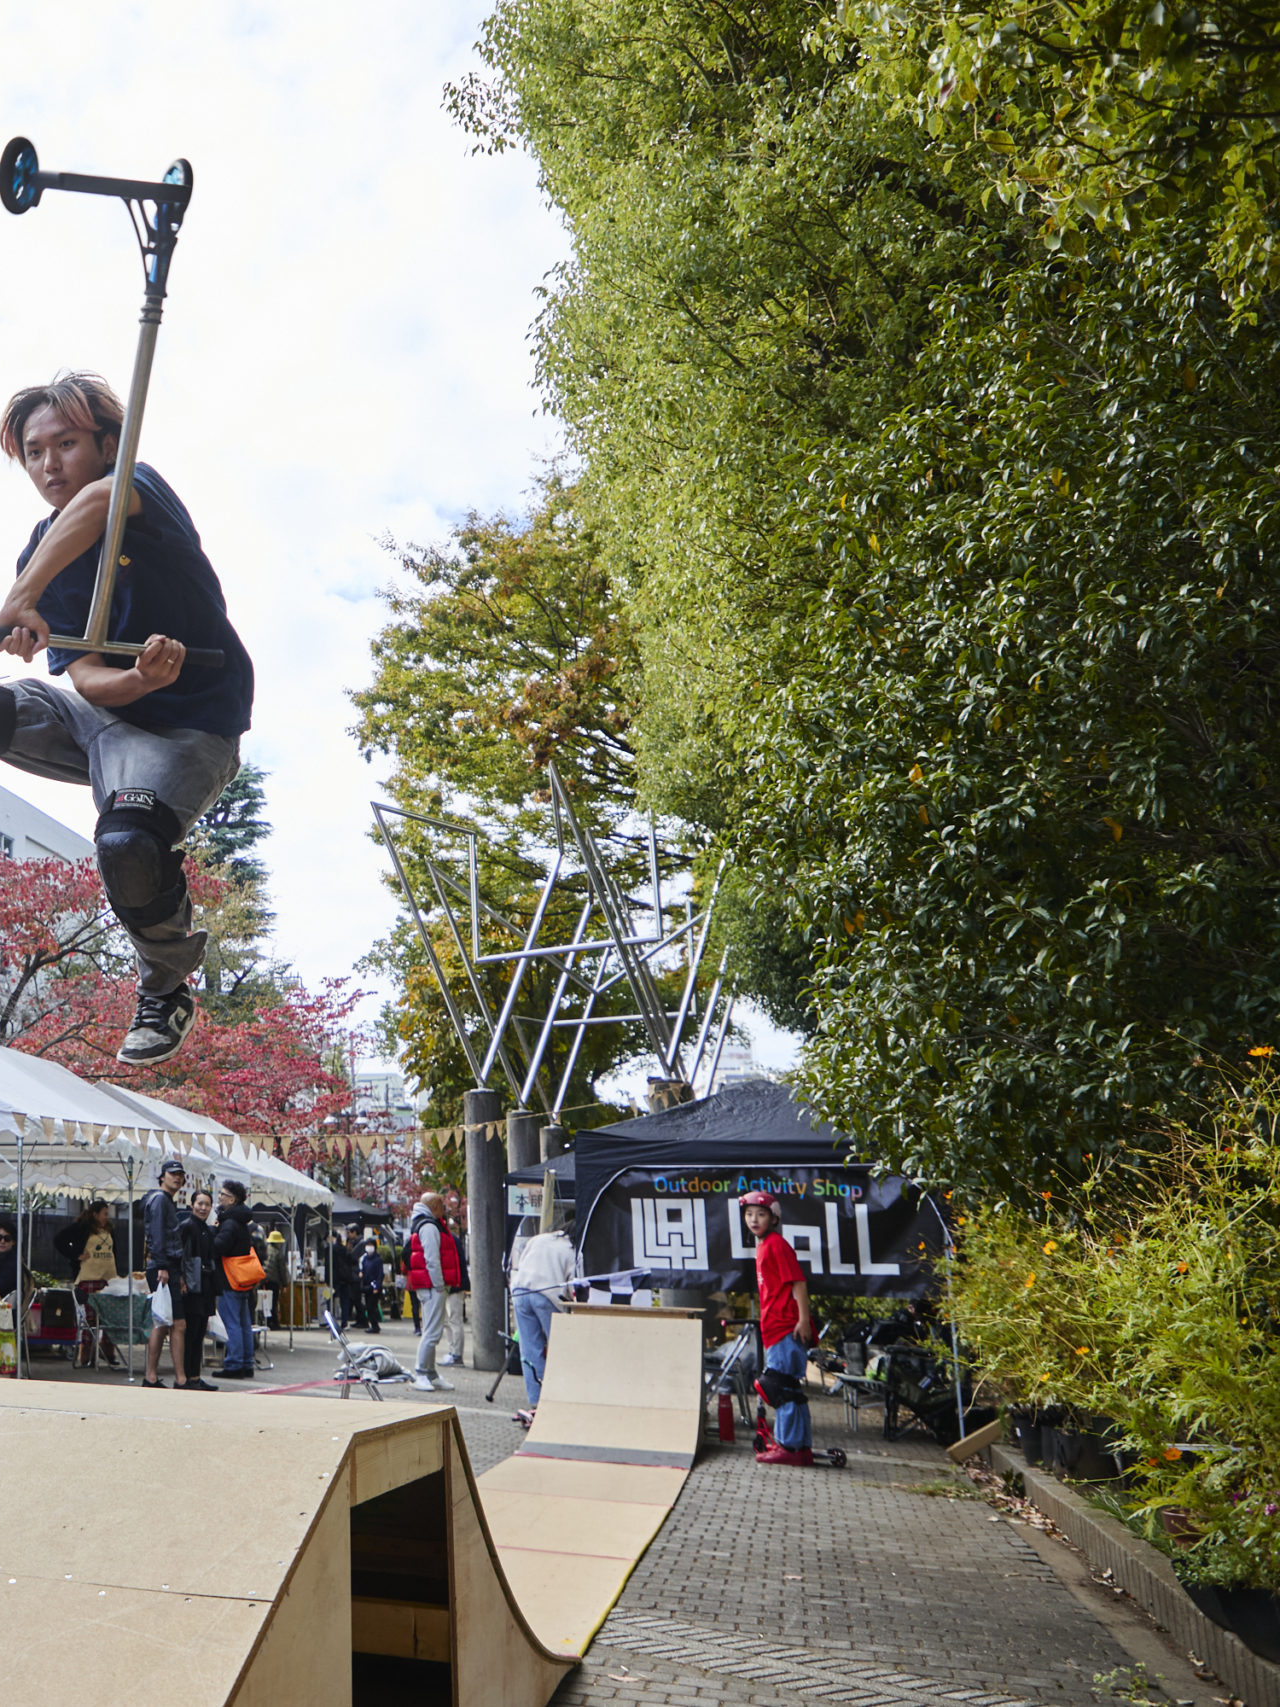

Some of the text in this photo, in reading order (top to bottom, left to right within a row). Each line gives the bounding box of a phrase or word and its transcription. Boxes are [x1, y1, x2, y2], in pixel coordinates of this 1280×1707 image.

[654, 1175, 863, 1202] Outdoor Activity Shop
